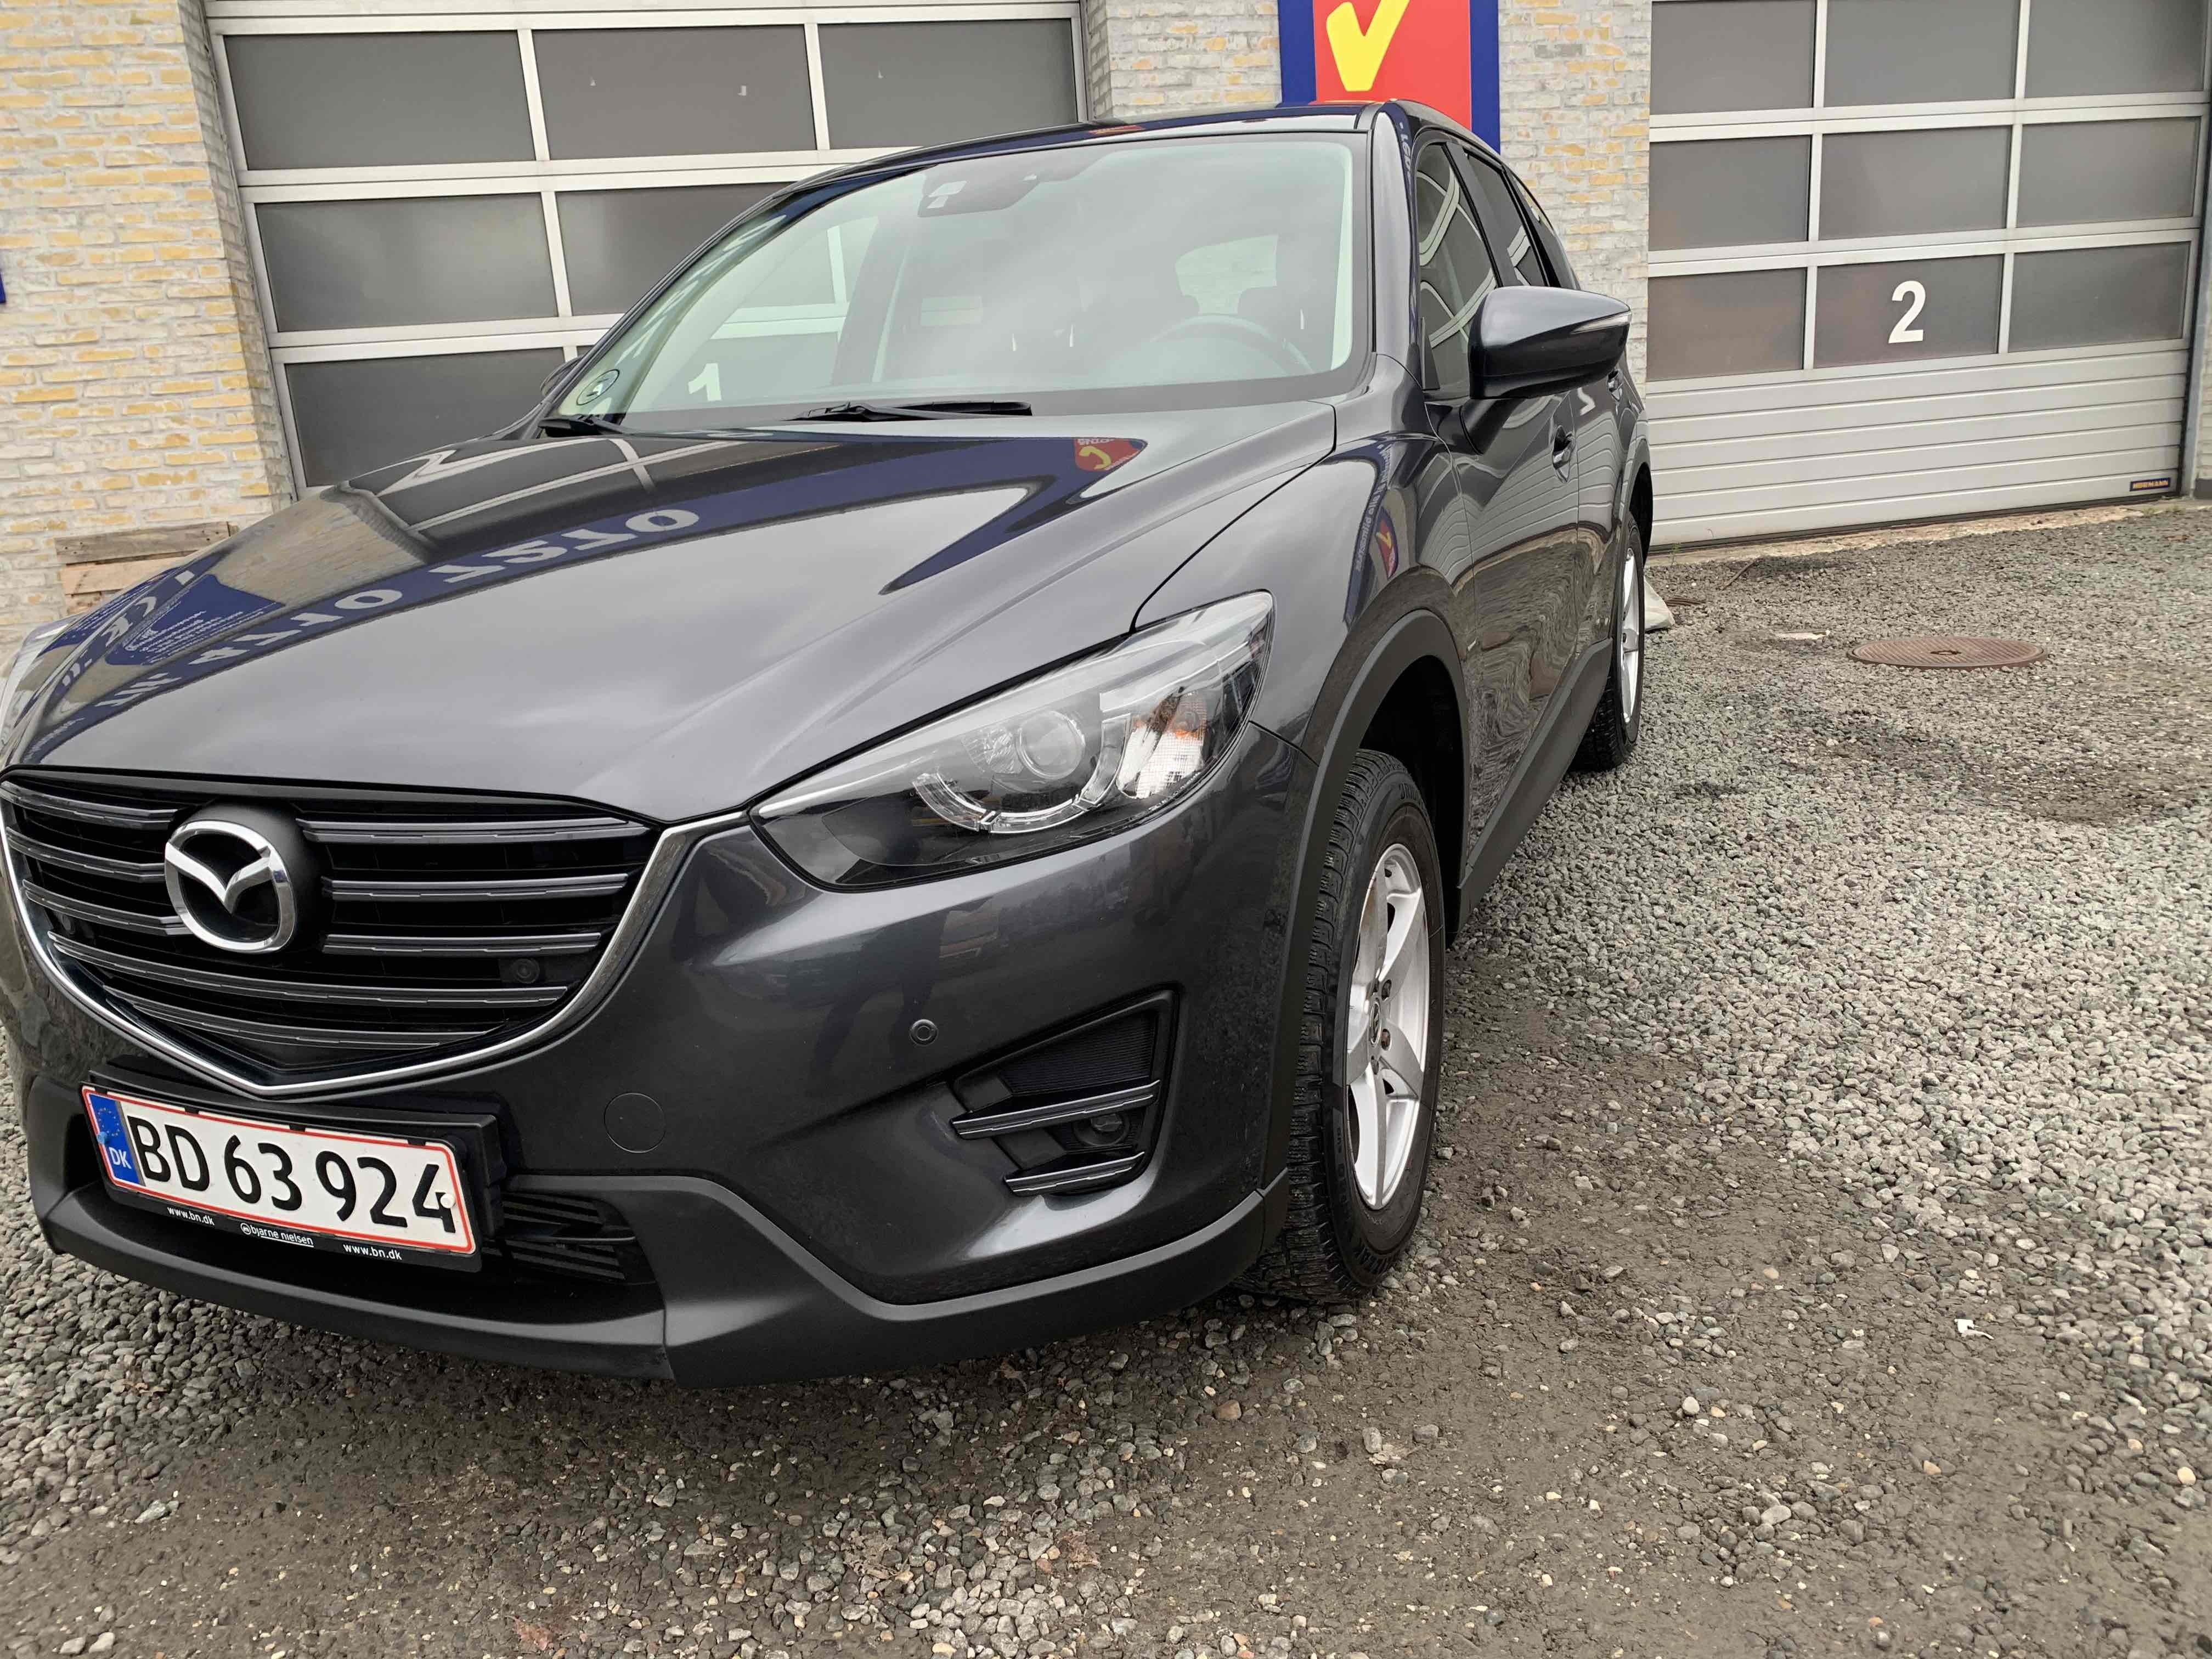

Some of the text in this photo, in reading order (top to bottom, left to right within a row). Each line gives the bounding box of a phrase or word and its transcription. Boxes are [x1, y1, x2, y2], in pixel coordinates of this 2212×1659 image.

[1888, 280, 1927, 343] 2
[688, 363, 721, 401] 1
[109, 1146, 132, 1170] DK
[128, 1115, 456, 1233] BD 63 924
[167, 1206, 215, 1226] www.bn.dk
[250, 1224, 314, 1245] bjarne nielsen
[343, 1243, 402, 1261] www.bn.dk
